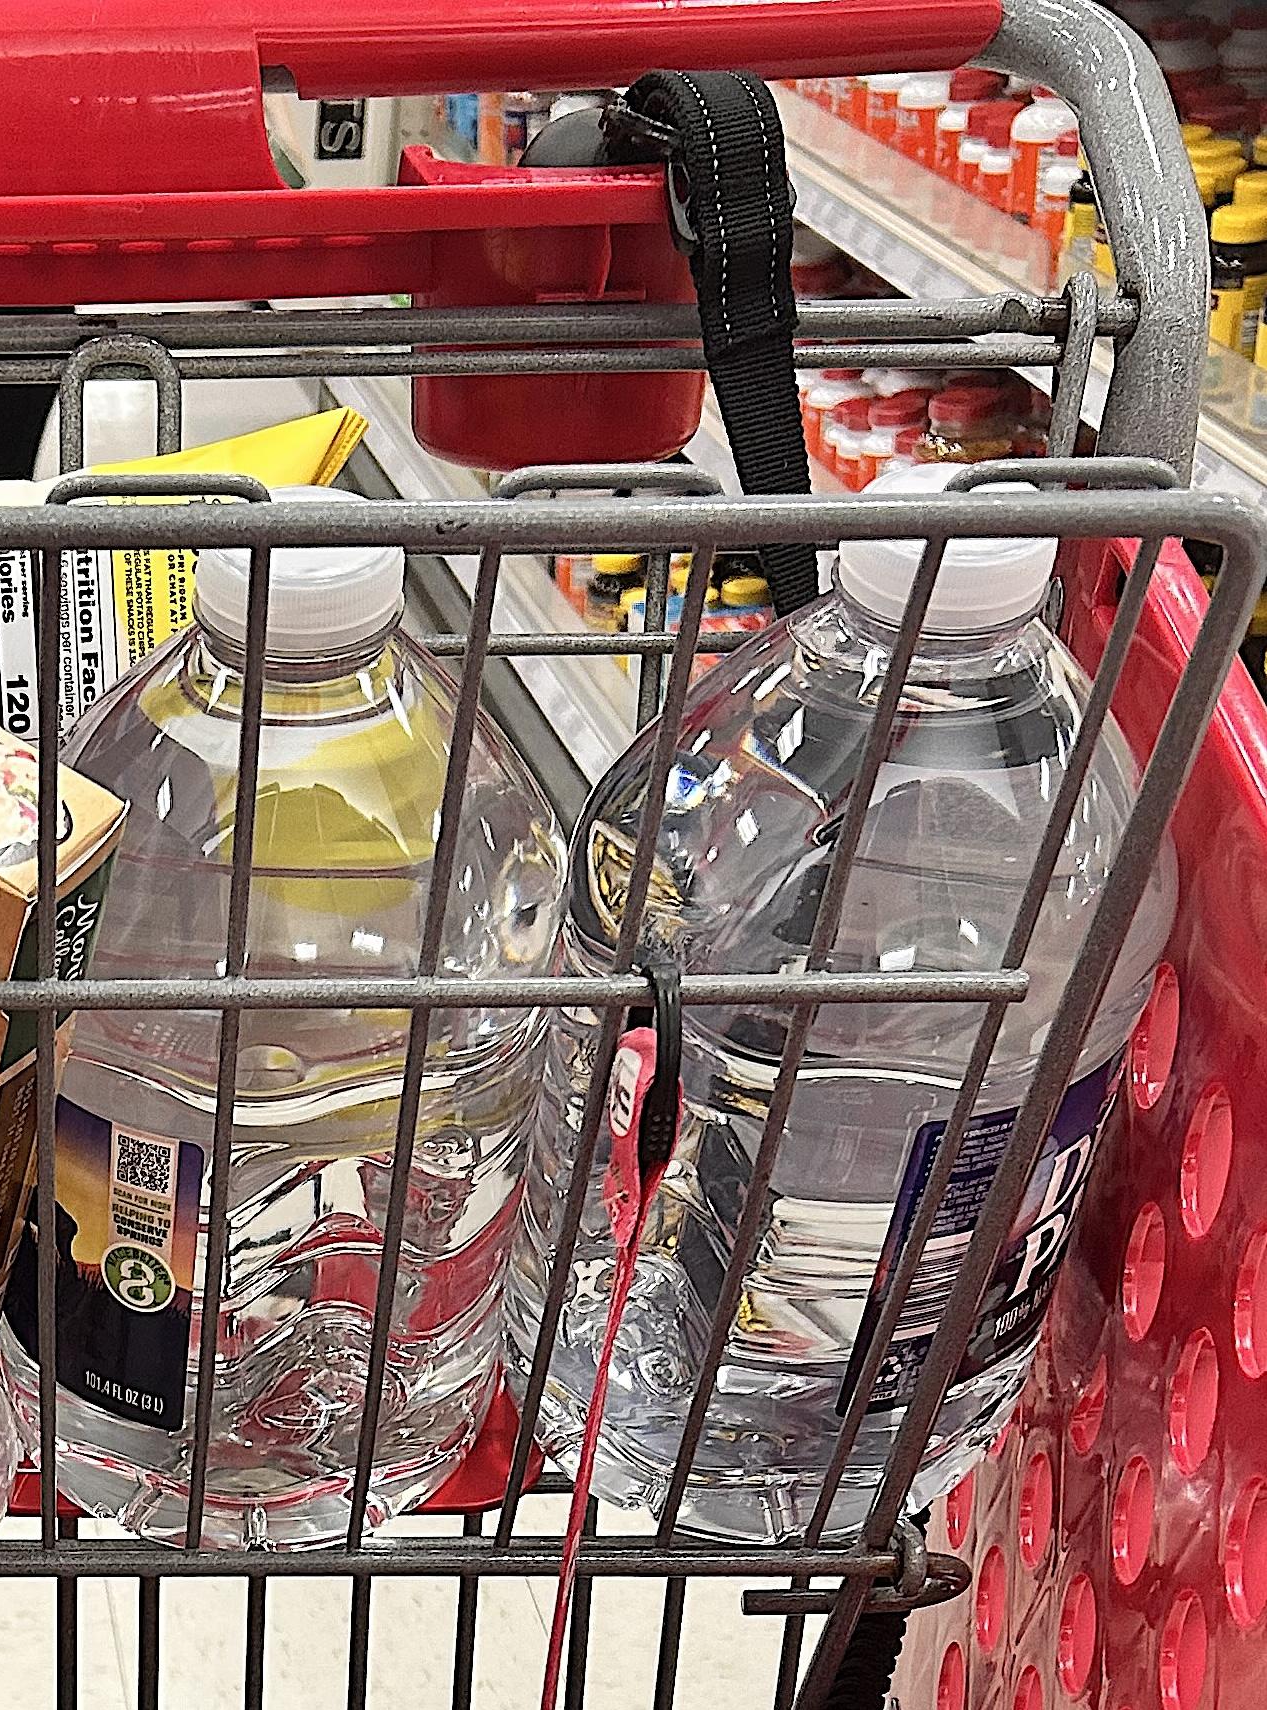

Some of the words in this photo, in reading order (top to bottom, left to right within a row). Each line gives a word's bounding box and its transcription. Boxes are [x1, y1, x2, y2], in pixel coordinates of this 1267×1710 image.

[73, 549, 98, 644] trition
[167, 573, 177, 604] CHAT
[169, 609, 177, 624] AT
[3, 674, 33, 734] 120
[79, 651, 102, 716] Fac
[83, 1369, 111, 1395] 101.4
[110, 1382, 125, 1401] FL
[123, 1387, 140, 1407] OZ
[139, 1391, 152, 1412] (3
